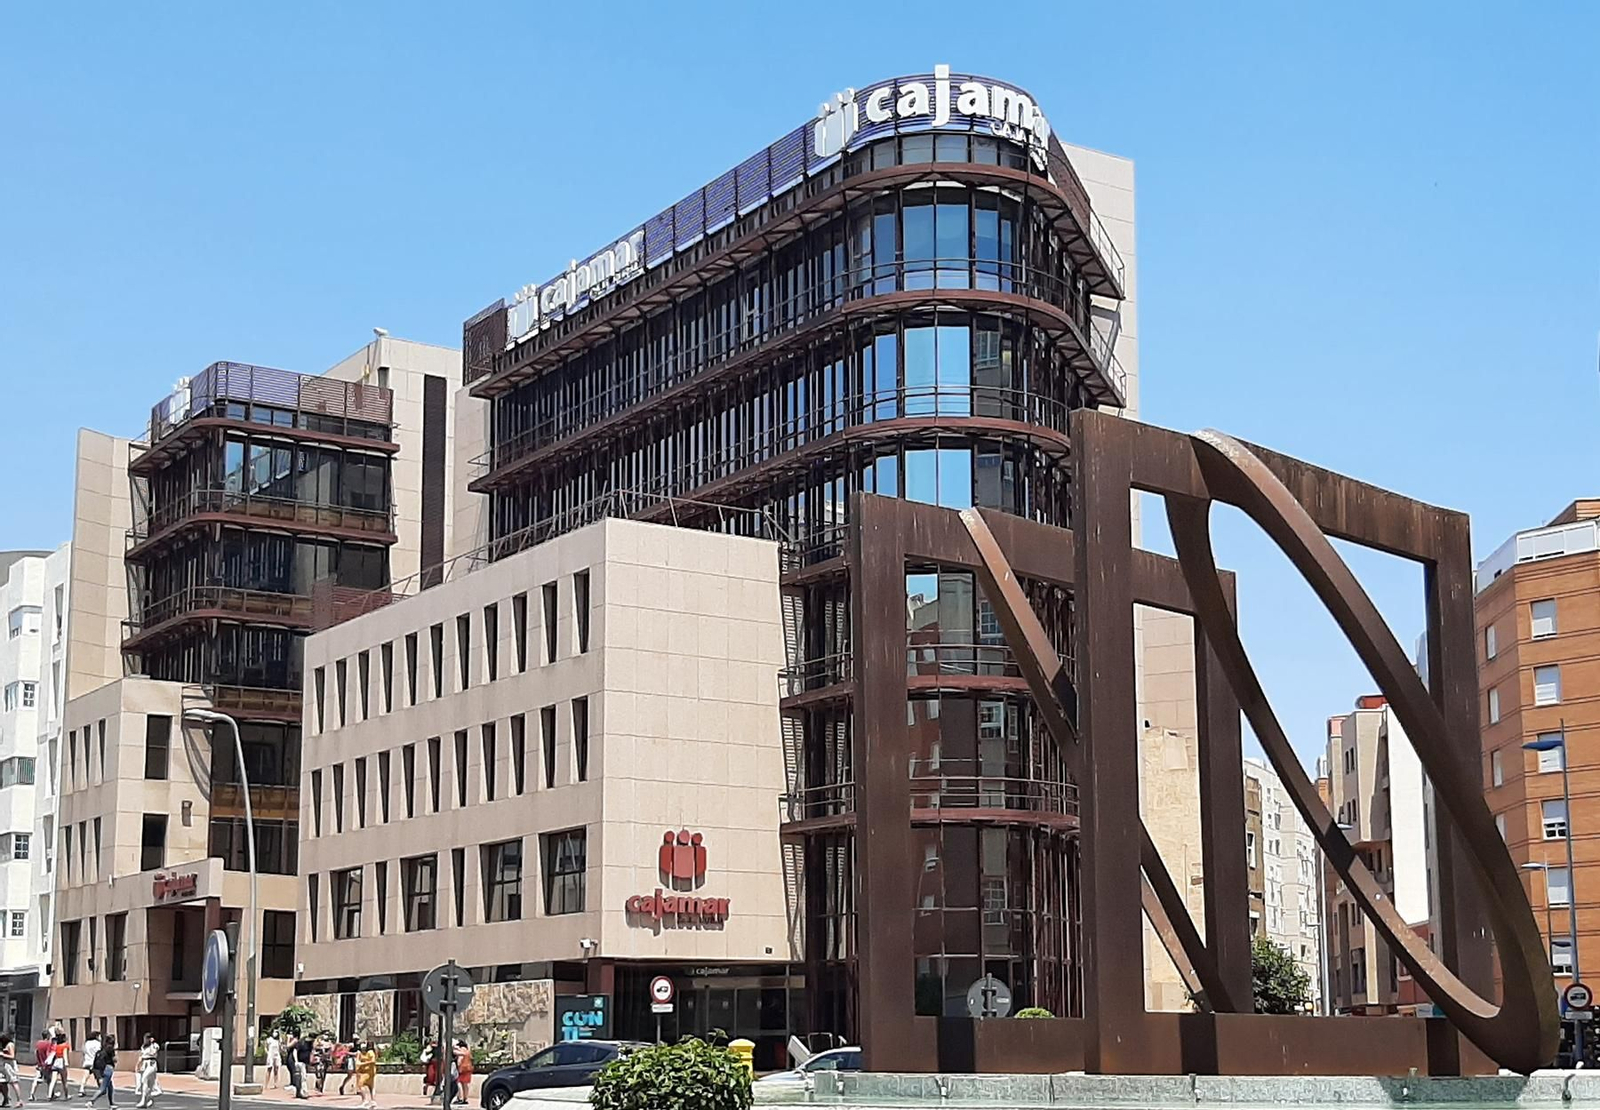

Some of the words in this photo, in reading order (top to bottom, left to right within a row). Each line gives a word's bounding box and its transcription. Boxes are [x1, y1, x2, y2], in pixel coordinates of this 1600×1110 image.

[866, 64, 1049, 150] cajama
[541, 230, 645, 315] cajamar
[625, 888, 730, 922] cajamar
[695, 966, 730, 977] cajamar
